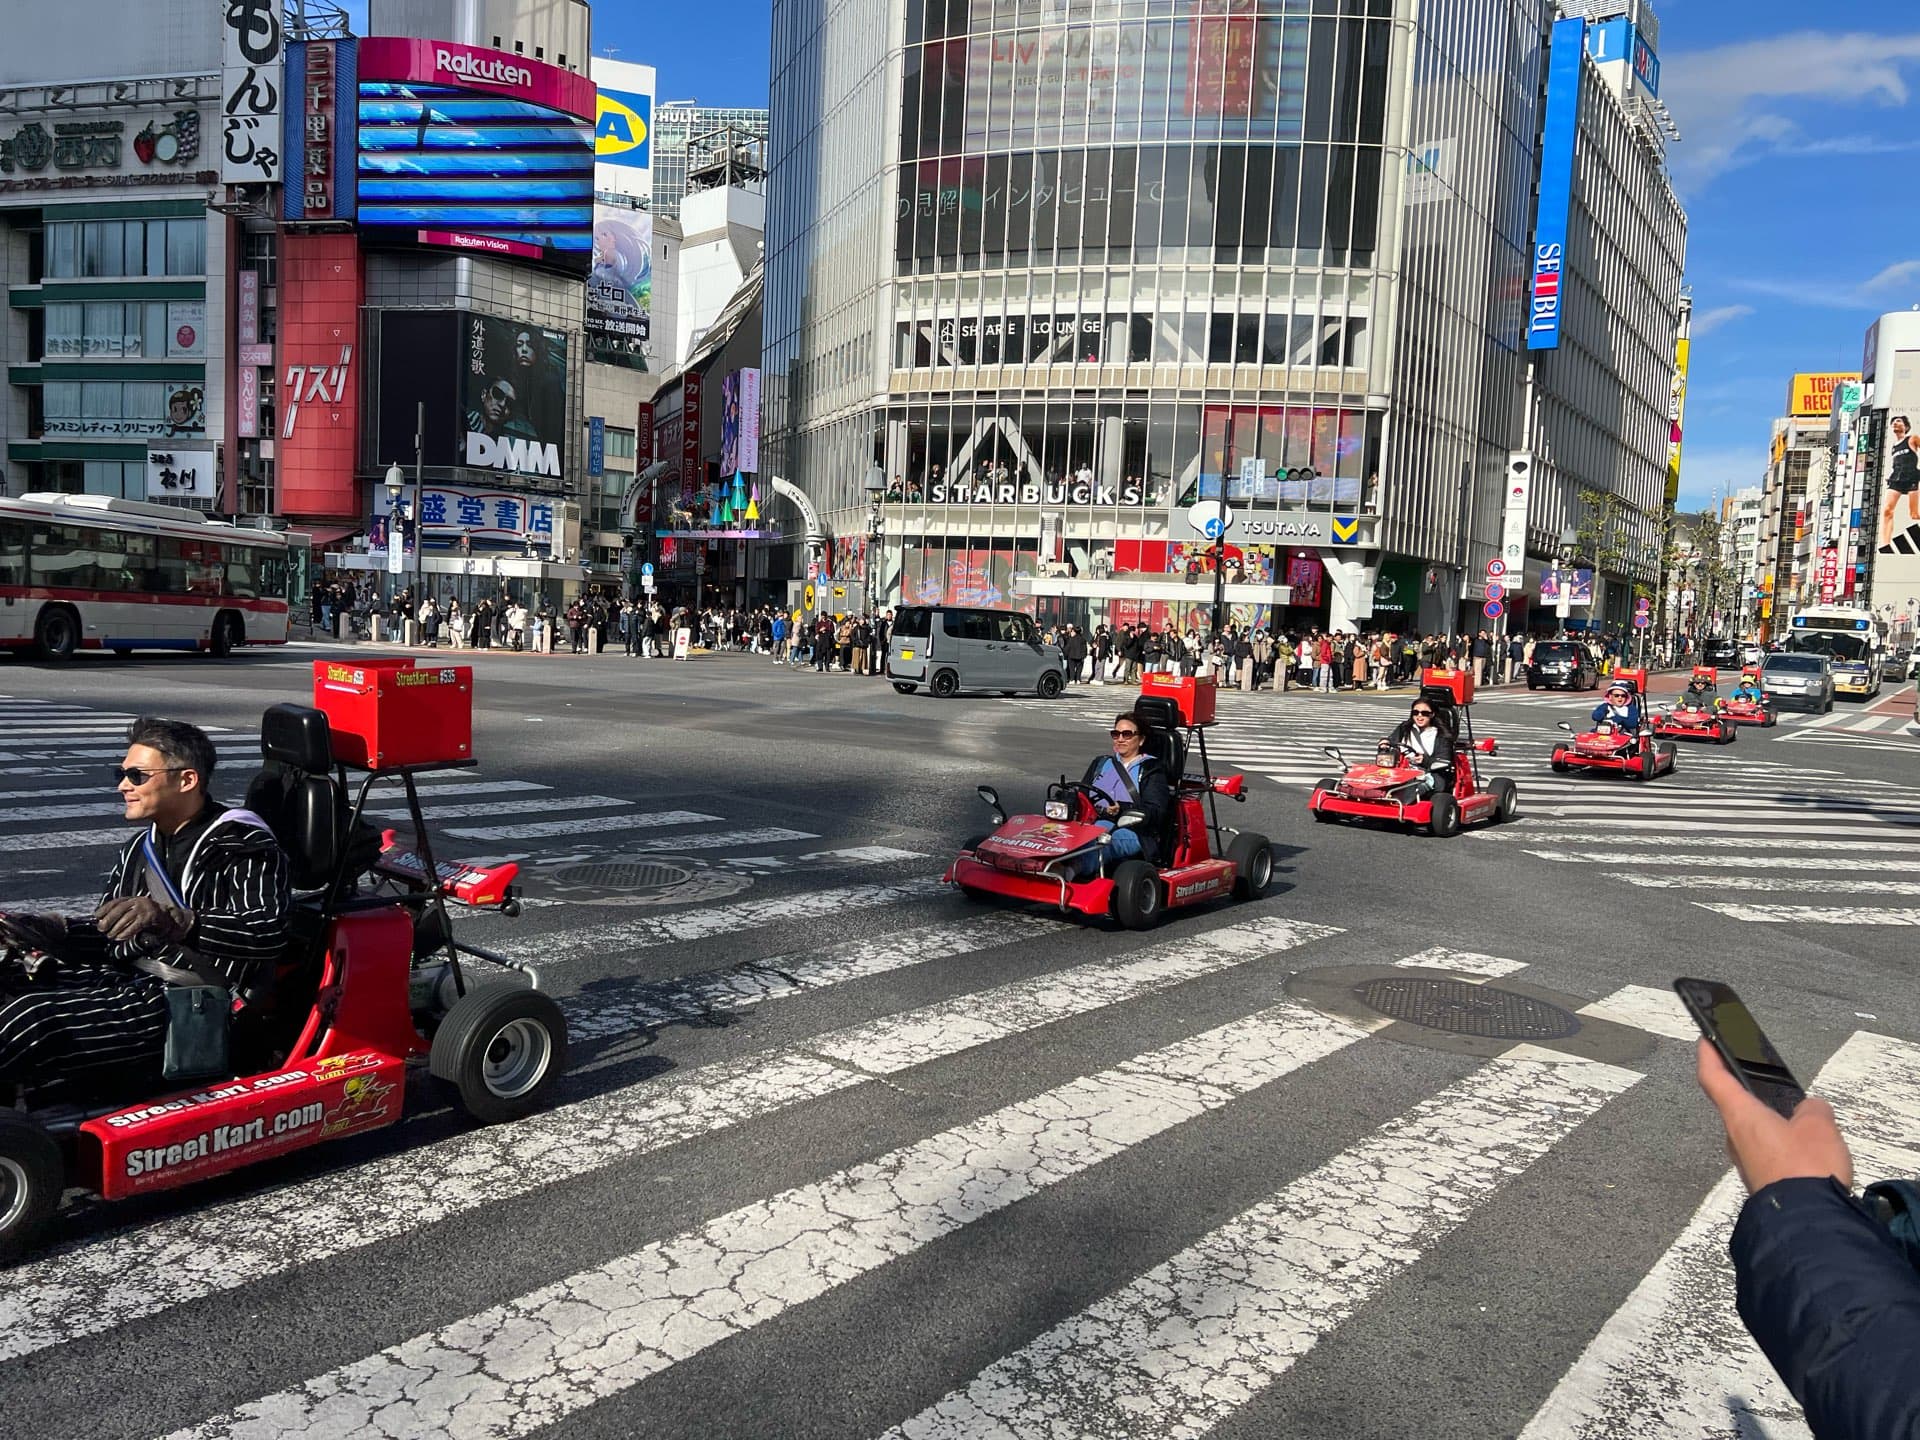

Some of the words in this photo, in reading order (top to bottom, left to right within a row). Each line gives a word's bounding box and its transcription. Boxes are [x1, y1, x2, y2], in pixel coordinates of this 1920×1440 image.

[224, 0, 280, 178] もんじゃ
[436, 49, 532, 87] Rakuten
[659, 110, 701, 123] HULIC
[455, 235, 484, 248] Rakuten
[485, 239, 509, 251] Vision
[1531, 243, 1561, 333] SEIBU
[471, 319, 486, 376] 外道の歌
[604, 319, 647, 337] 放送開始
[961, 321, 1017, 337] SHARE
[1032, 317, 1101, 334] LOUNGE
[282, 345, 353, 439] クスリ
[684, 383, 700, 449] カラオケ
[466, 431, 561, 477] DMM
[1820, 446, 1834, 500] KARAOKE
[931, 484, 1141, 506] STARBUCKS
[1242, 520, 1322, 538] TSUTAYA
[1019, 839, 1043, 849] Kart
[106, 1098, 196, 1128] Street
[192, 1081, 250, 1103] Kart
[253, 1069, 309, 1090] .com
[126, 1134, 208, 1176] Street
[213, 1116, 266, 1153] Kart
[267, 1101, 324, 1137] .com
